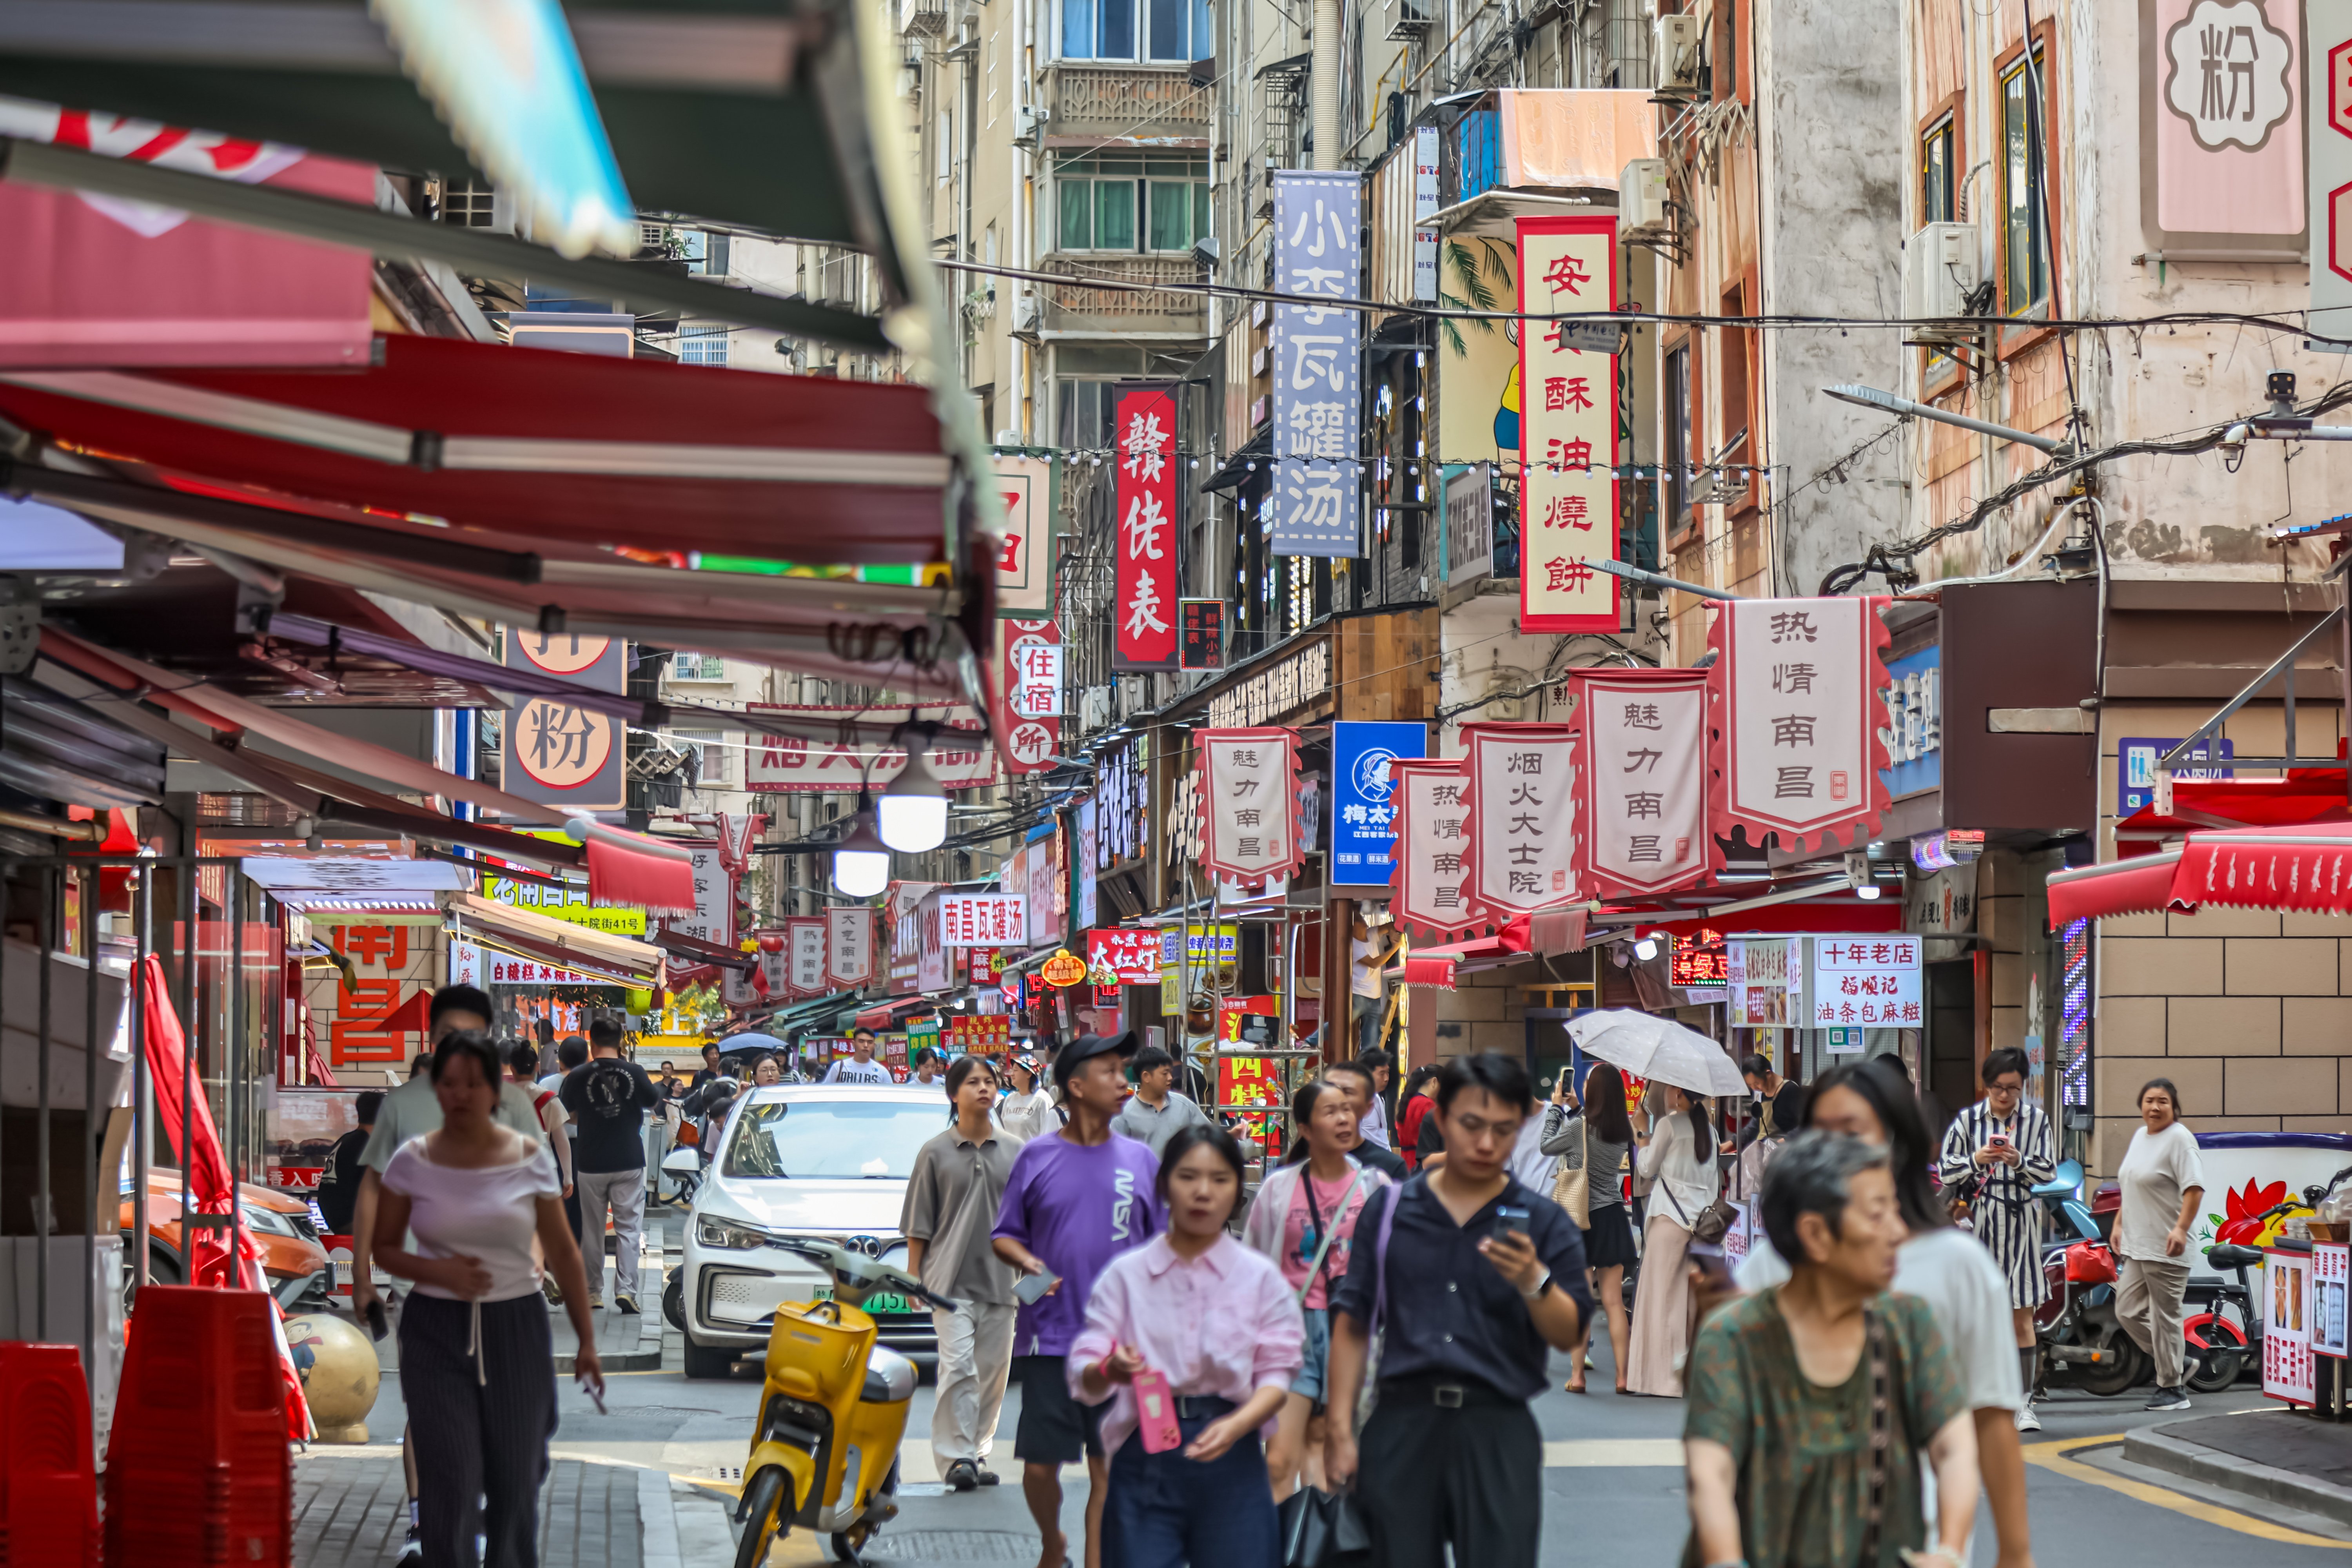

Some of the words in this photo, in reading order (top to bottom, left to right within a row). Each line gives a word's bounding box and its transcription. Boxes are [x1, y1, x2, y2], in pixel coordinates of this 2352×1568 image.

[2200, 24, 2259, 122] 粉
[1289, 200, 1348, 526] 小李瓦罐汤
[1025, 649, 1055, 712] 住宿
[1771, 612, 1818, 799] 热情南昌
[1232, 750, 1260, 857] 魅力南昌
[1624, 703, 1662, 862] 魅力南昌
[1432, 785, 1461, 908] 热情南昌
[1508, 753, 1543, 894] 烟火大士院
[1339, 855, 1359, 863] 花果酒
[1369, 855, 1388, 863] 鲜米酒
[842, 915, 856, 973] 大气南昌
[945, 899, 1022, 942] 南昌瓦罐汤
[1111, 933, 1138, 947] 水煮
[494, 963, 535, 981] 白糖糕
[803, 930, 817, 984] 热情南昌
[1091, 942, 1161, 973] 大红灯
[1825, 943, 1913, 964] 十年老店
[333, 926, 407, 1066] 南昌
[1817, 1001, 1920, 1024] 油条包麻糍
[1840, 975, 1898, 996] 福顺记
[1112, 1169, 1134, 1241] NASA
